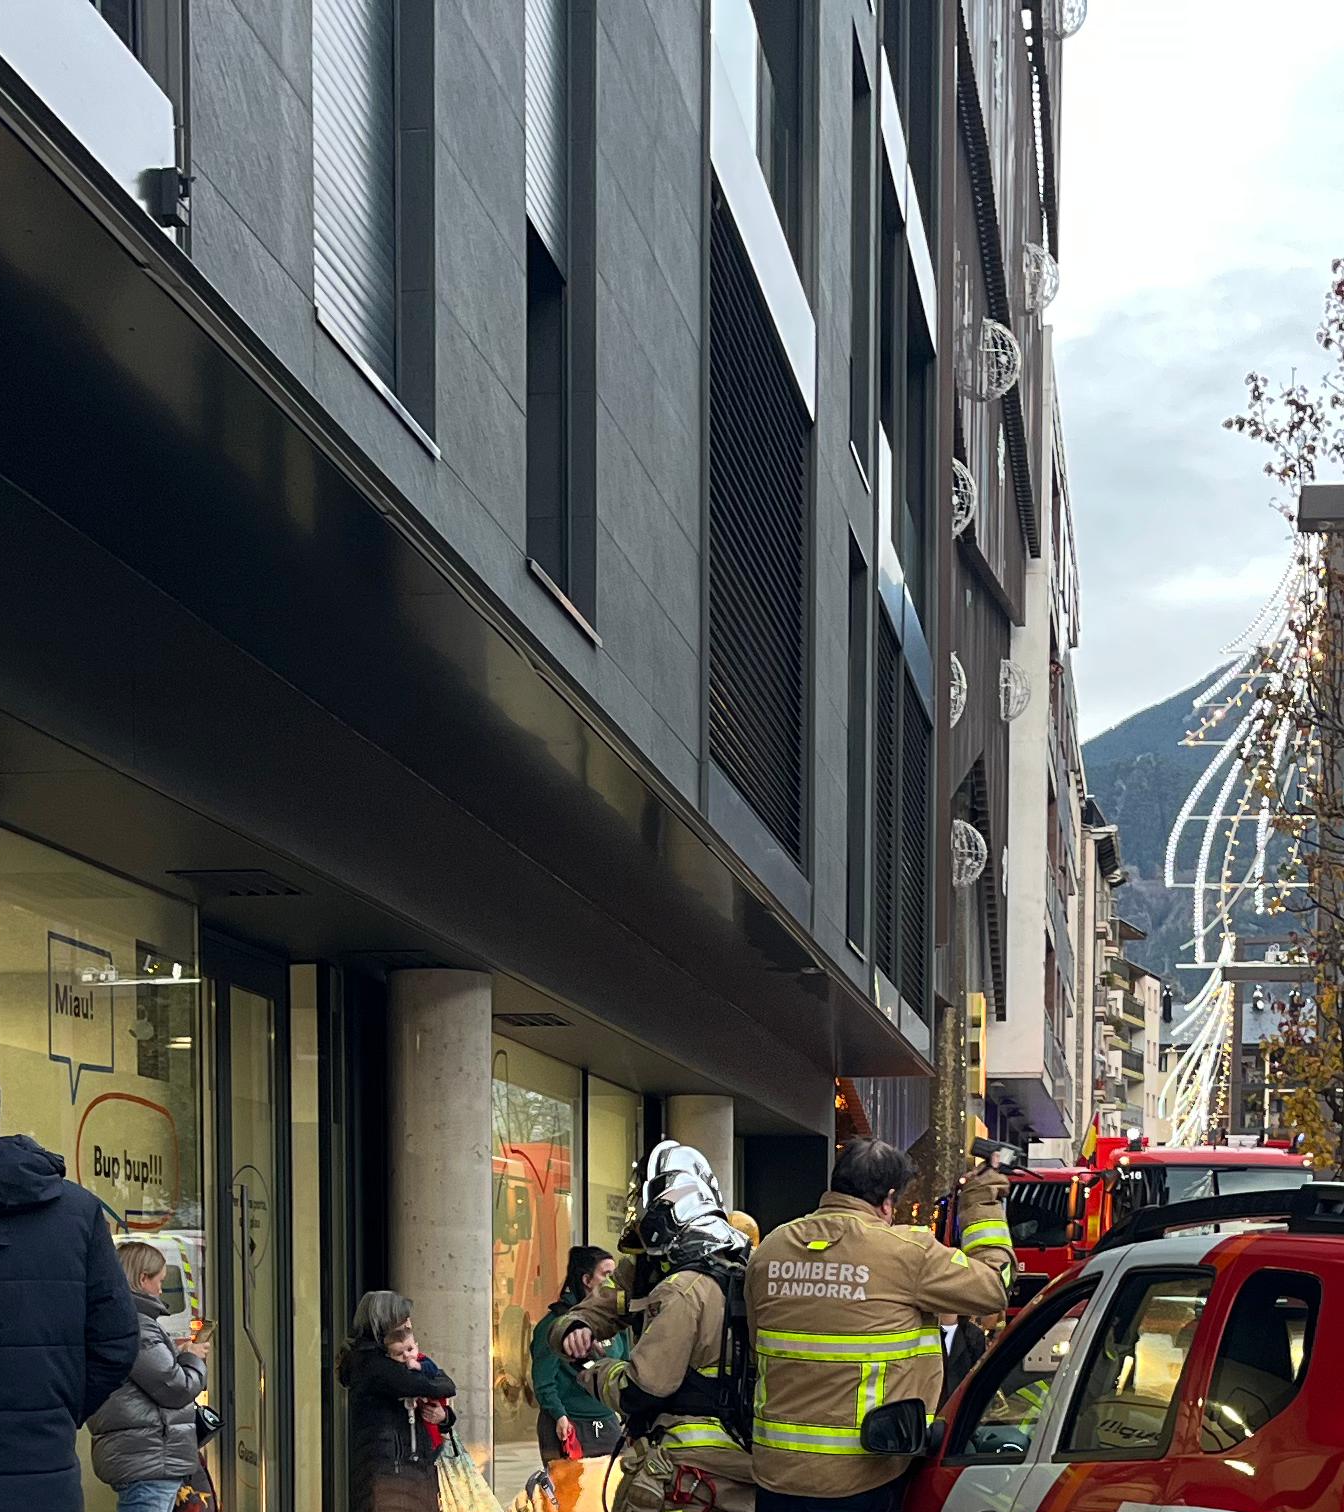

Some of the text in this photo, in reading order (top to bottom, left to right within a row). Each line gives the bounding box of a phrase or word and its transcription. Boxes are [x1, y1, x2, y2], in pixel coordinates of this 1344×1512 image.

[55, 983, 94, 1020] Miau!
[94, 1146, 163, 1190] Bup bup!!!
[768, 1260, 870, 1284] BOMBERS
[767, 1281, 866, 1301] D'ANDORRA
